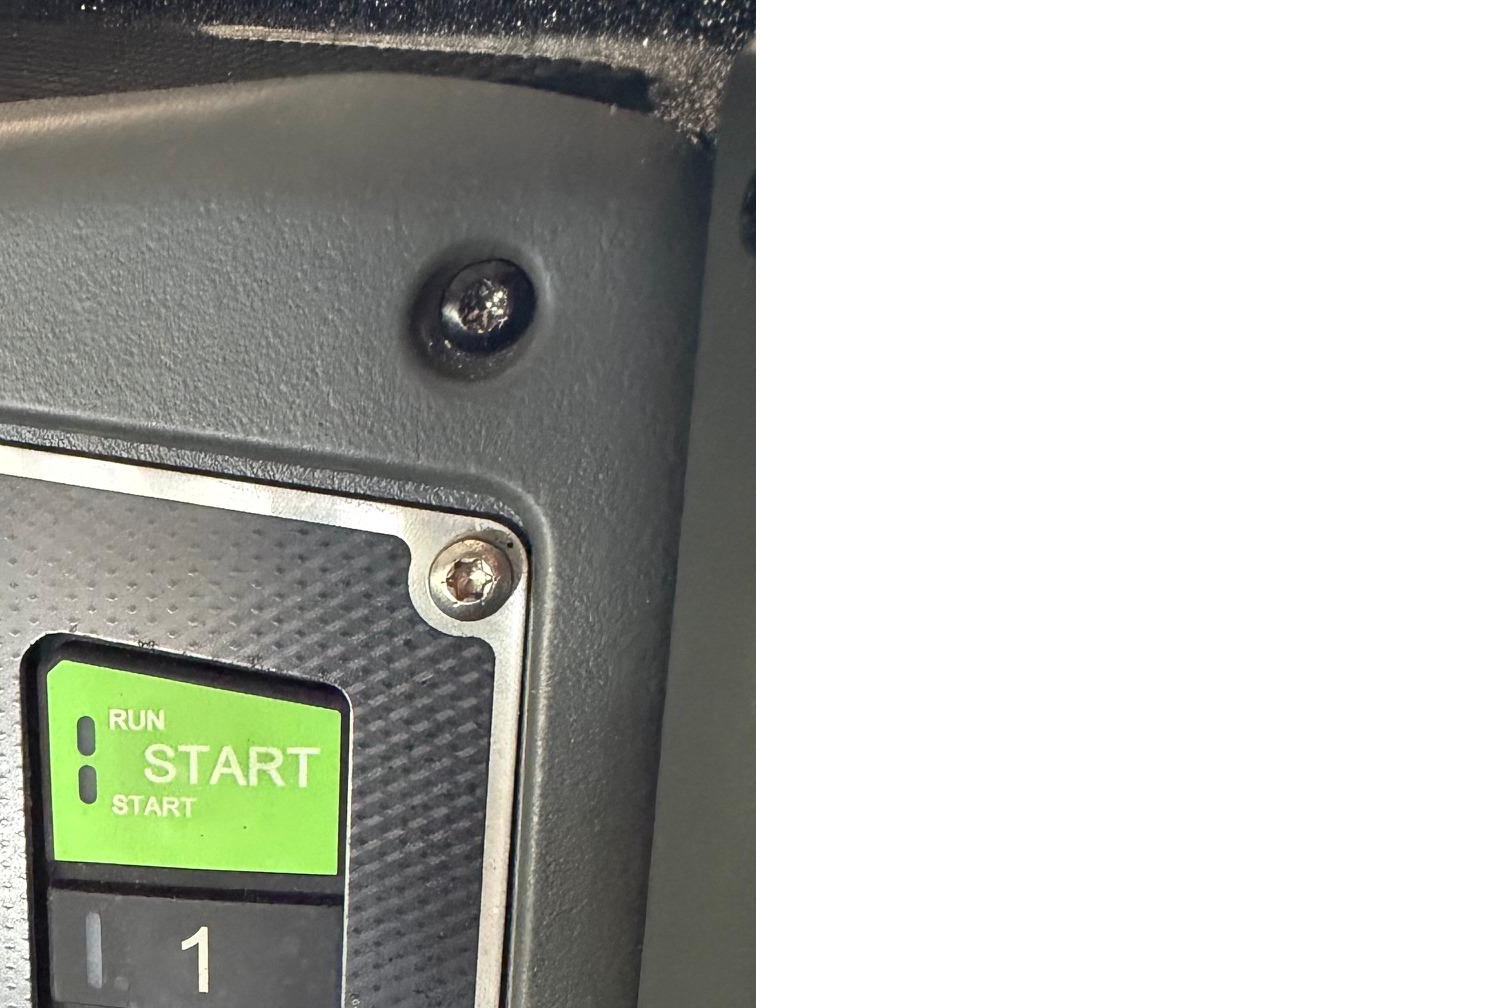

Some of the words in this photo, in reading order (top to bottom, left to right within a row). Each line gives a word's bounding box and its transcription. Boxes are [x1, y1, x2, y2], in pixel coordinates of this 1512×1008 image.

[108, 709, 165, 732] RUN
[144, 744, 321, 787] START
[111, 795, 197, 818] START
[181, 926, 209, 993] 1
